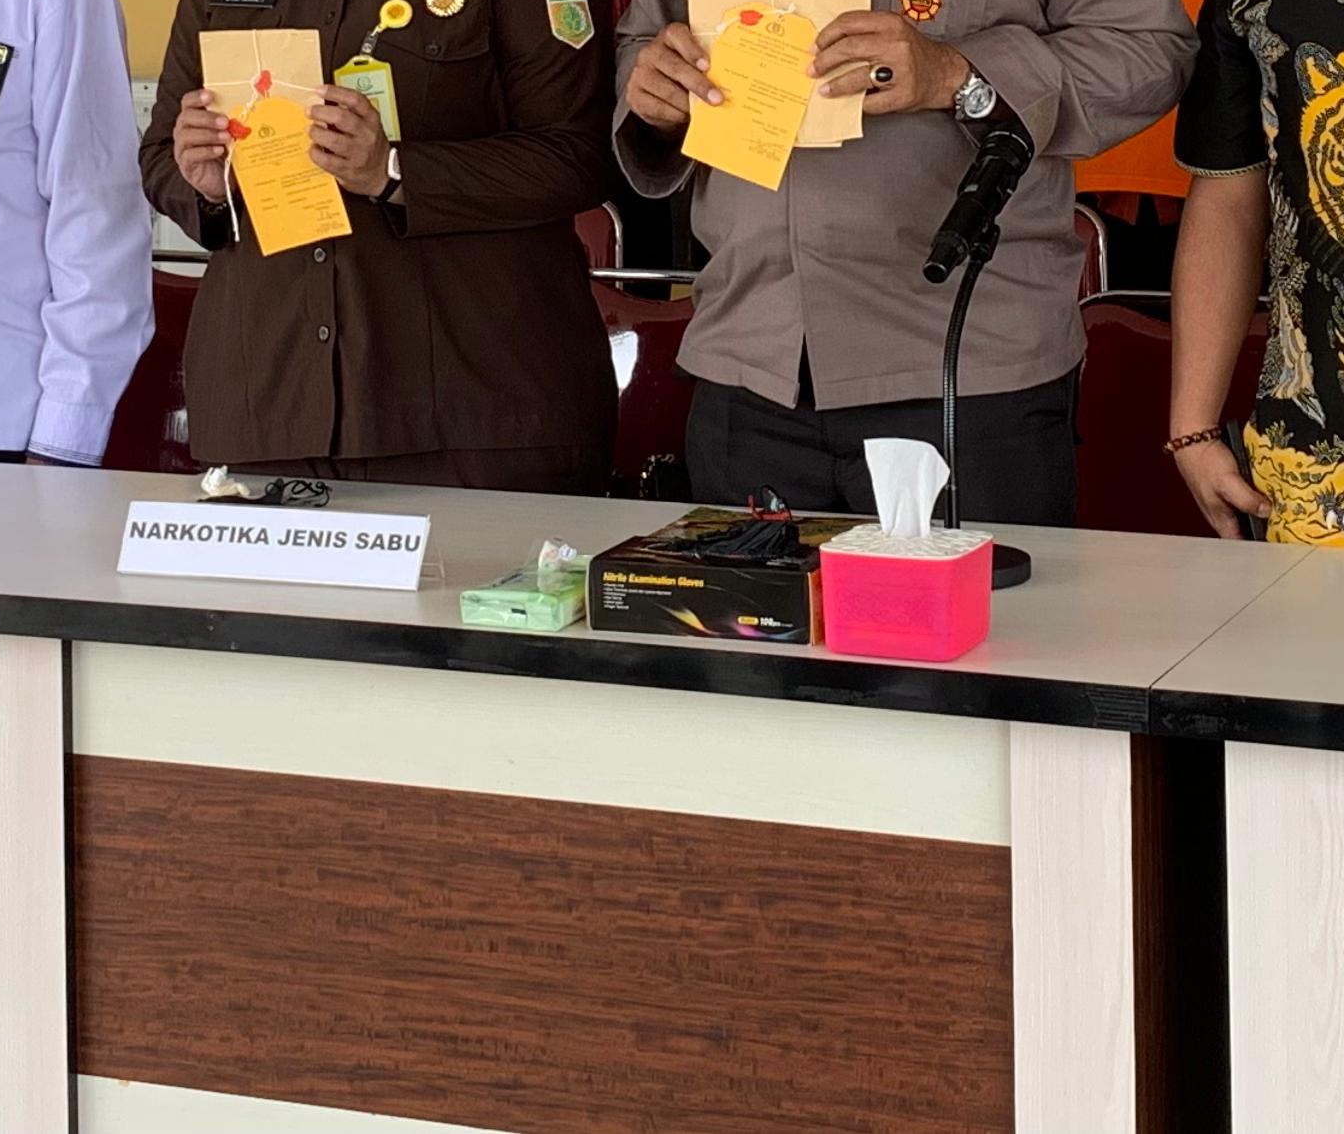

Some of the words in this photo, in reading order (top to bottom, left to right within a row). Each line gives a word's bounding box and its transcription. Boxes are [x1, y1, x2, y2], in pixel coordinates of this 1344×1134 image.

[128, 521, 270, 546] NARKOTIKA
[277, 528, 348, 549] JENIS
[355, 532, 421, 552] SABU
[678, 577, 704, 588] Gloves
